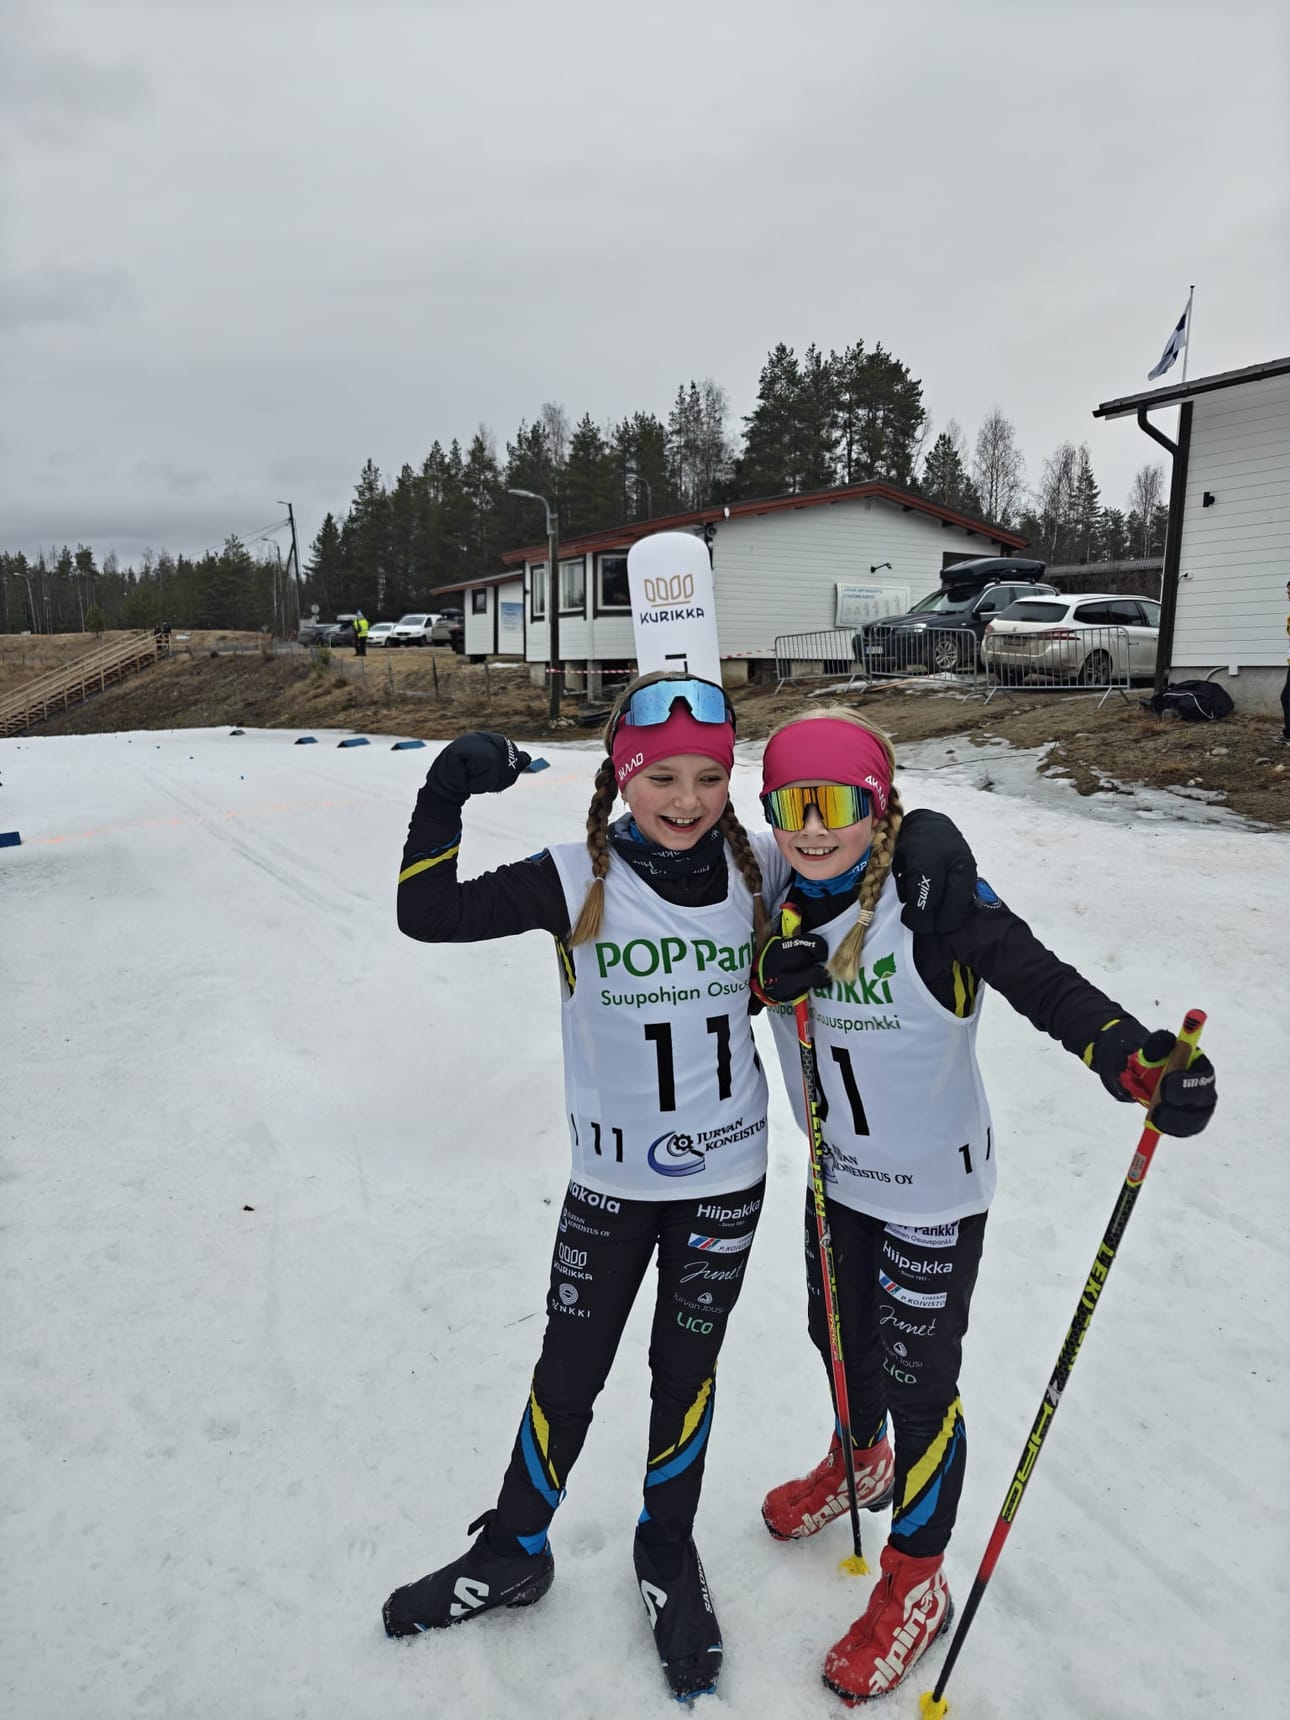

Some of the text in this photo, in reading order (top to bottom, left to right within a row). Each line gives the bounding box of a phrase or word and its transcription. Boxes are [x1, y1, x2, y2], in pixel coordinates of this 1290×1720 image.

[640, 608, 704, 626] KURIKKA
[595, 937, 687, 978] POP
[601, 986, 700, 1008] Suupohjan
[644, 1014, 732, 1112] 11
[705, 1117, 767, 1151] KONEISTUS
[895, 1174, 913, 1185] OY
[697, 1200, 760, 1222] Hiipakka
[882, 1240, 953, 1274] Hiipakka
[677, 1311, 713, 1334] LICO
